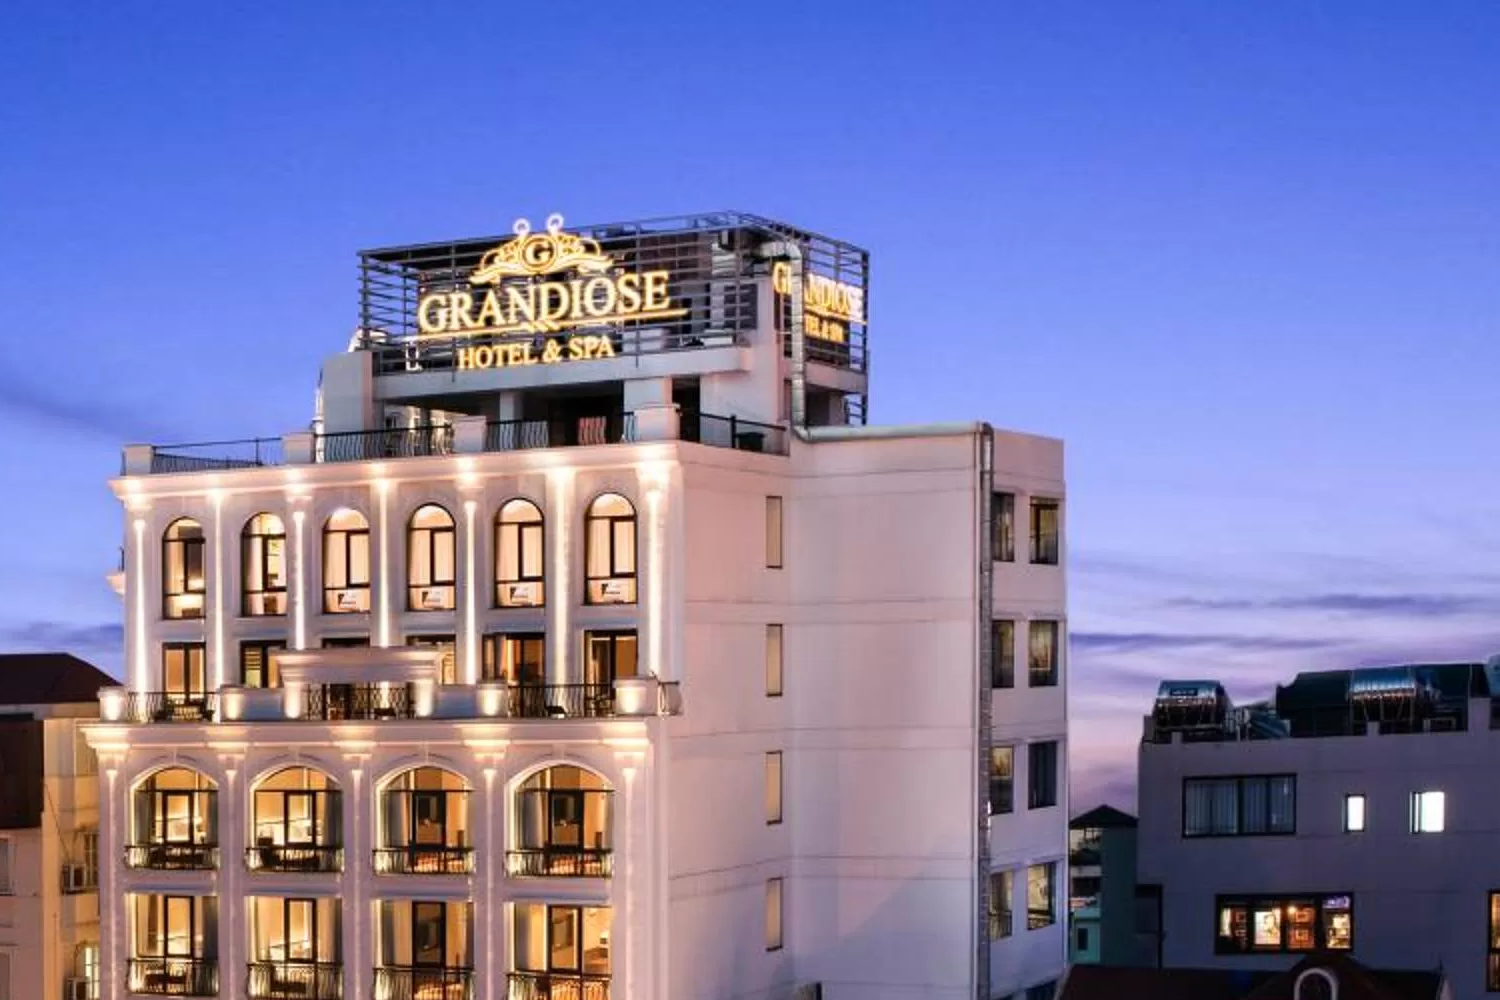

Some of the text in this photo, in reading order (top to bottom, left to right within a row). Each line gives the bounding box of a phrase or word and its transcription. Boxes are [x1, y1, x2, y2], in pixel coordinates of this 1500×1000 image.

[525, 240, 550, 265] G
[418, 270, 670, 332] GRANDIOSE
[458, 335, 616, 370] HOTEL & SPA
